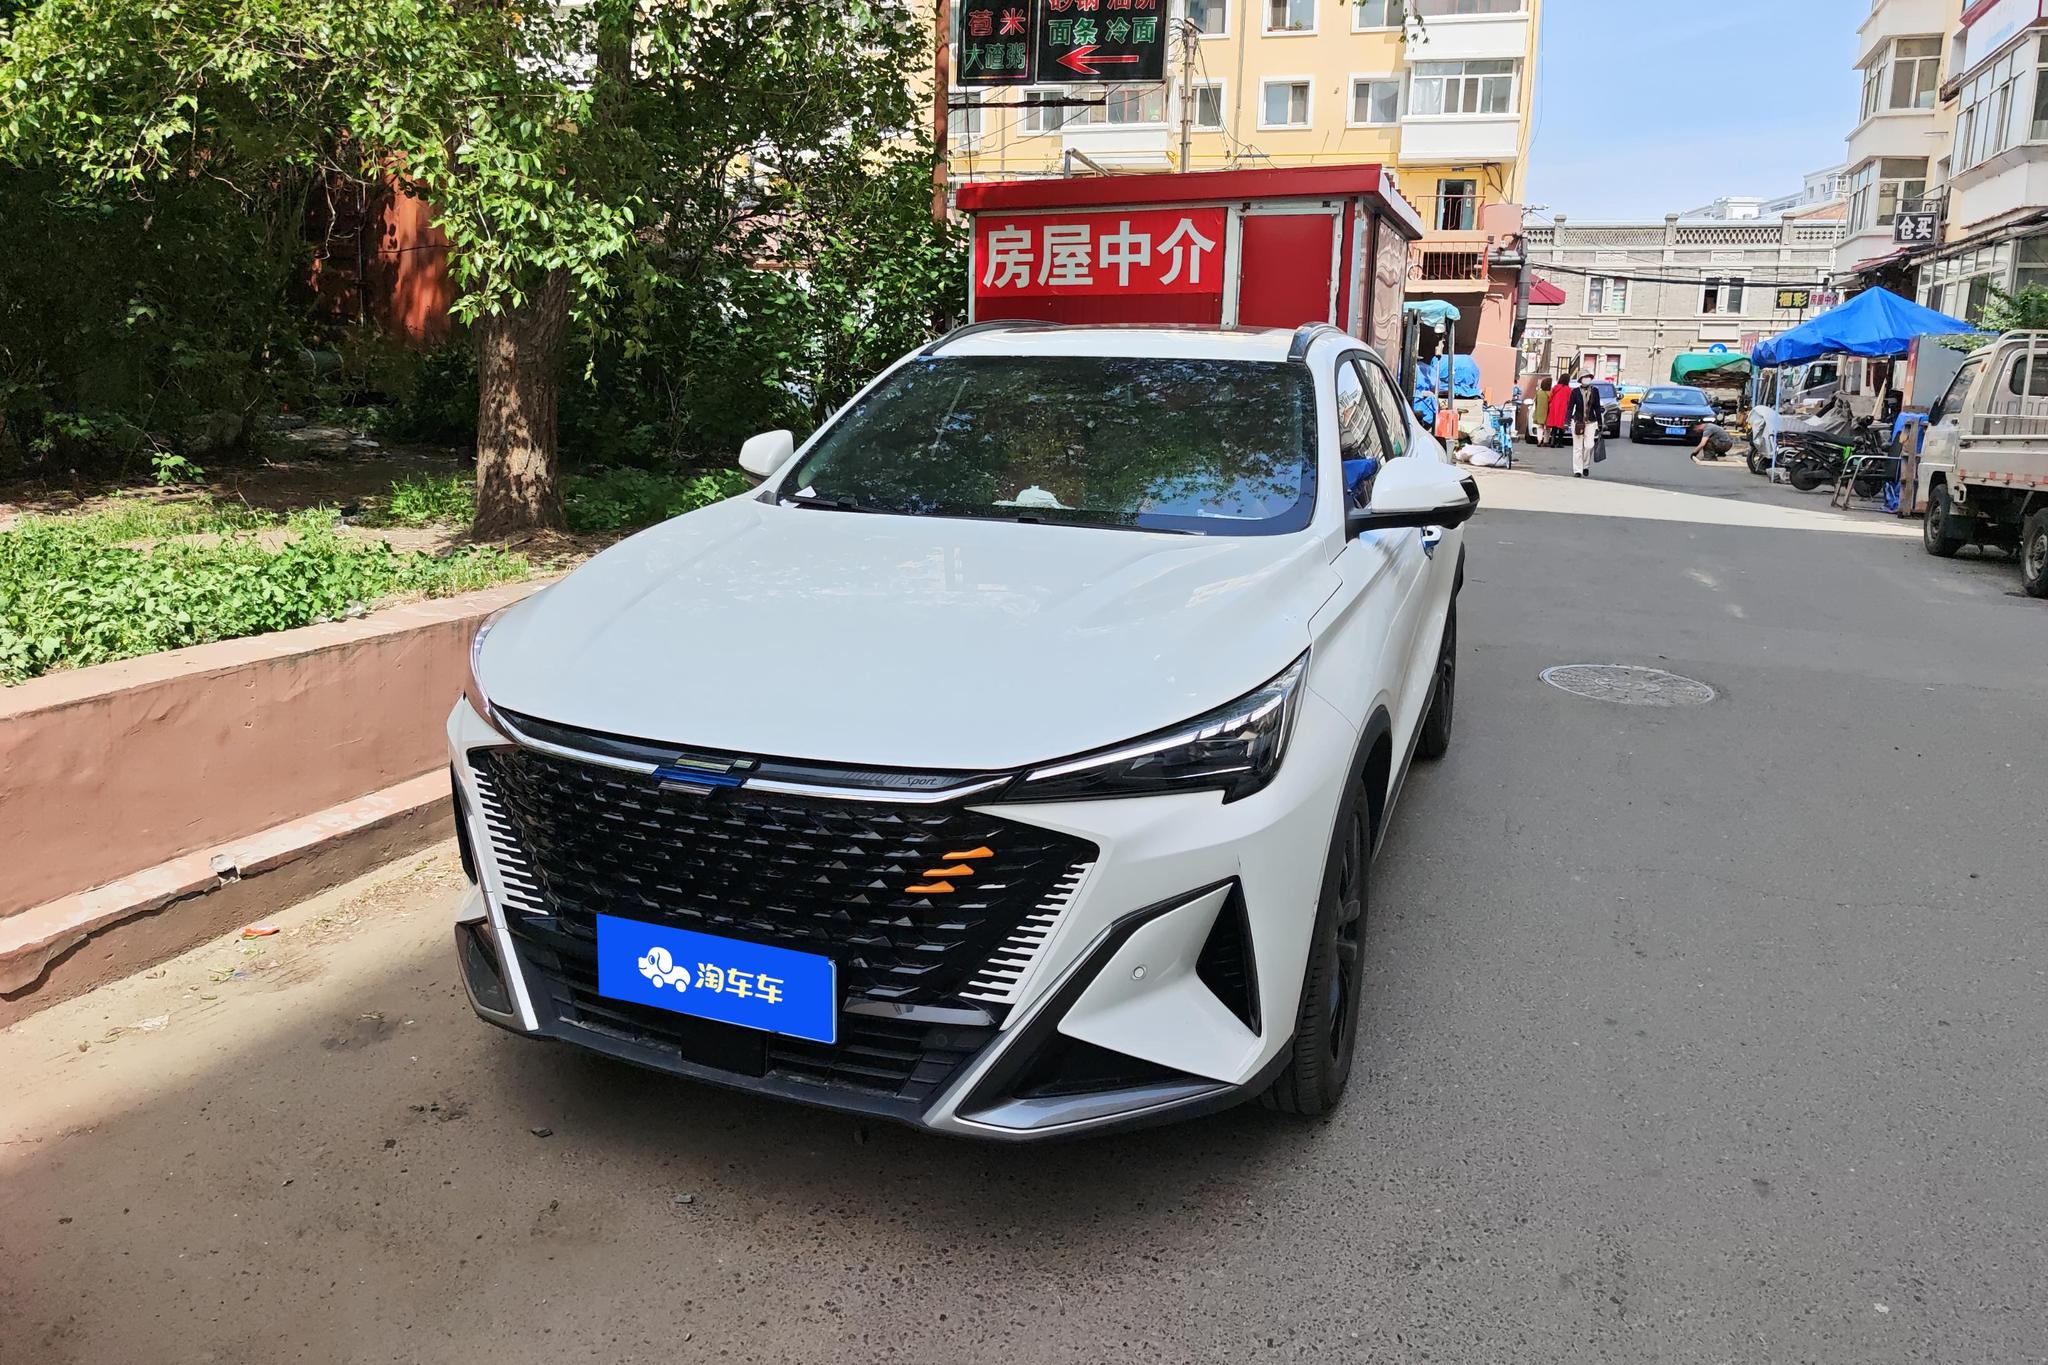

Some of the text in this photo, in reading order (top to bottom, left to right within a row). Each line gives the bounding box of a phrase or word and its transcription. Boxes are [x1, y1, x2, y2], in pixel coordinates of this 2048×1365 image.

[1048, 16, 1158, 46] 面条 冷面
[1898, 216, 1933, 240] 仓买
[982, 217, 1216, 289] 房屋中介
[904, 777, 938, 788] Sport
